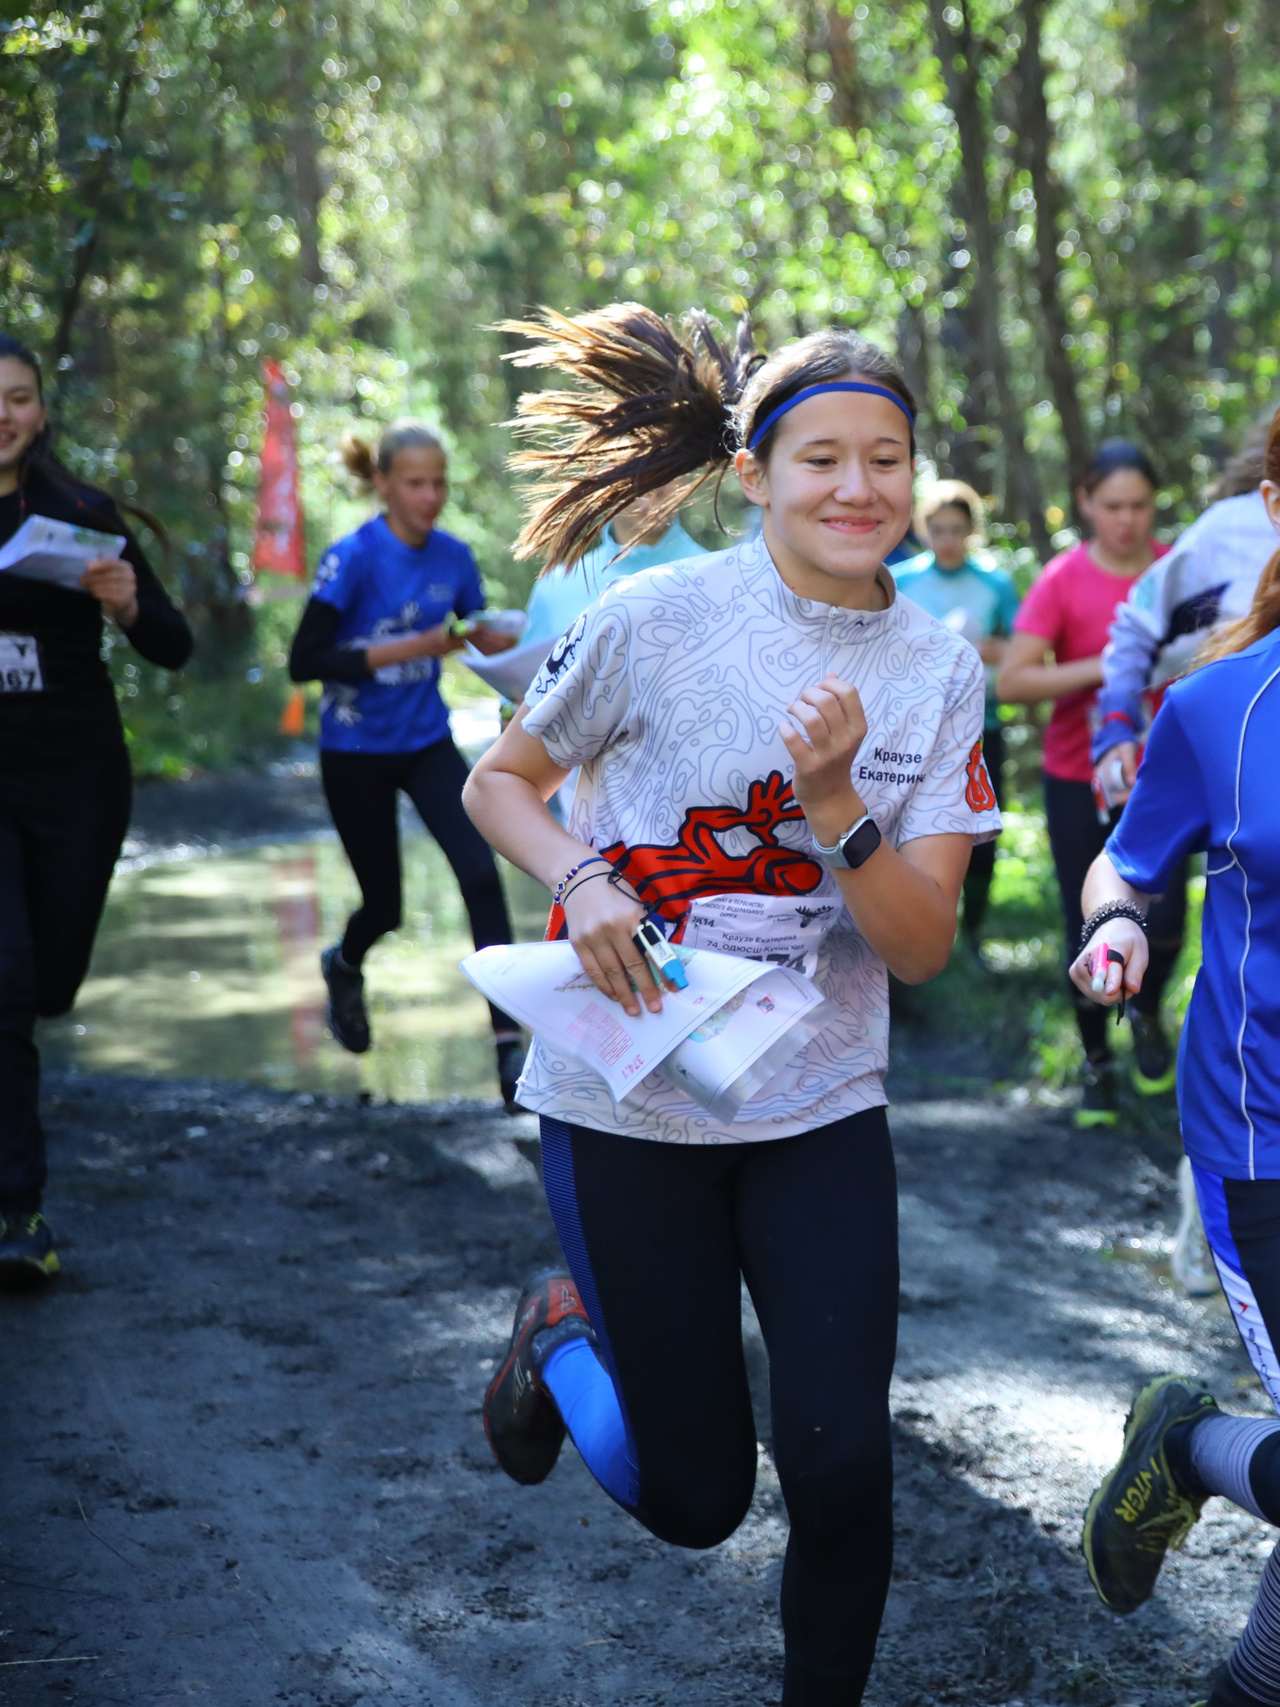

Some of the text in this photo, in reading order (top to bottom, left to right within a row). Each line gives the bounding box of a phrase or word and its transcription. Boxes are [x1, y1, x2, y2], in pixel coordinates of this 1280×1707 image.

[874, 747, 922, 765] Краузе
[859, 767, 926, 785] Екатерин
[692, 916, 714, 928] Ж14
[722, 932, 797, 943] Краузе Екатерина
